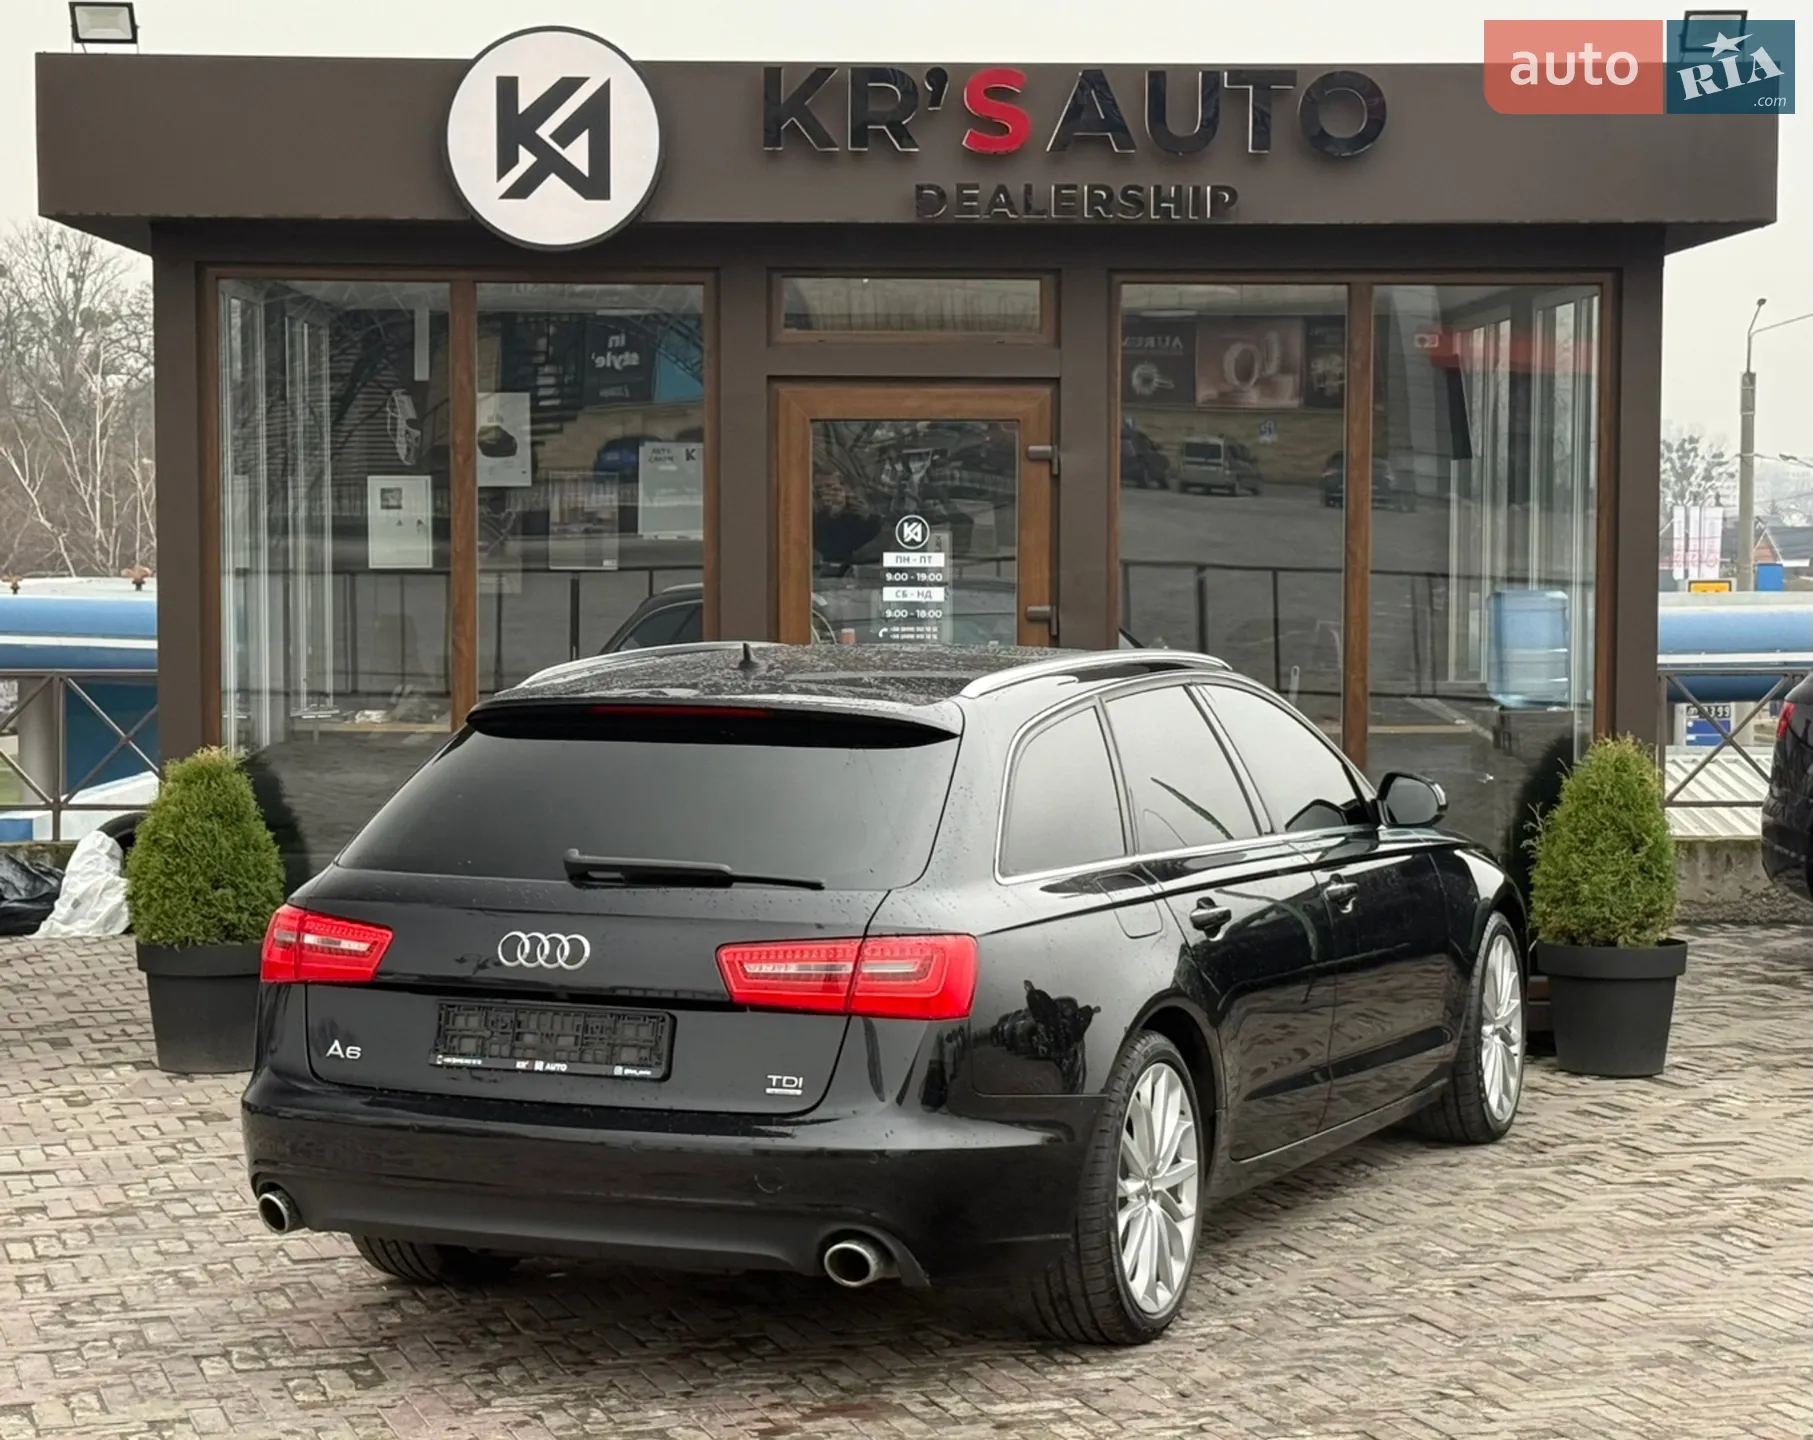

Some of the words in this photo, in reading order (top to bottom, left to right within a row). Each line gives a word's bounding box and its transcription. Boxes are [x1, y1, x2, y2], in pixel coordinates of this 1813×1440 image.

[762, 66, 1031, 155] KR'S
[1046, 68, 1387, 158] AUTO
[914, 183, 1239, 220] DEALERSHIP
[895, 555, 910, 564] ПН
[919, 555, 932, 564] ПТ
[895, 590, 908, 599] СБ
[917, 590, 933, 600] НД
[326, 1039, 362, 1060] A6
[545, 1062, 568, 1072] AUTO
[766, 1074, 804, 1089] TDI
